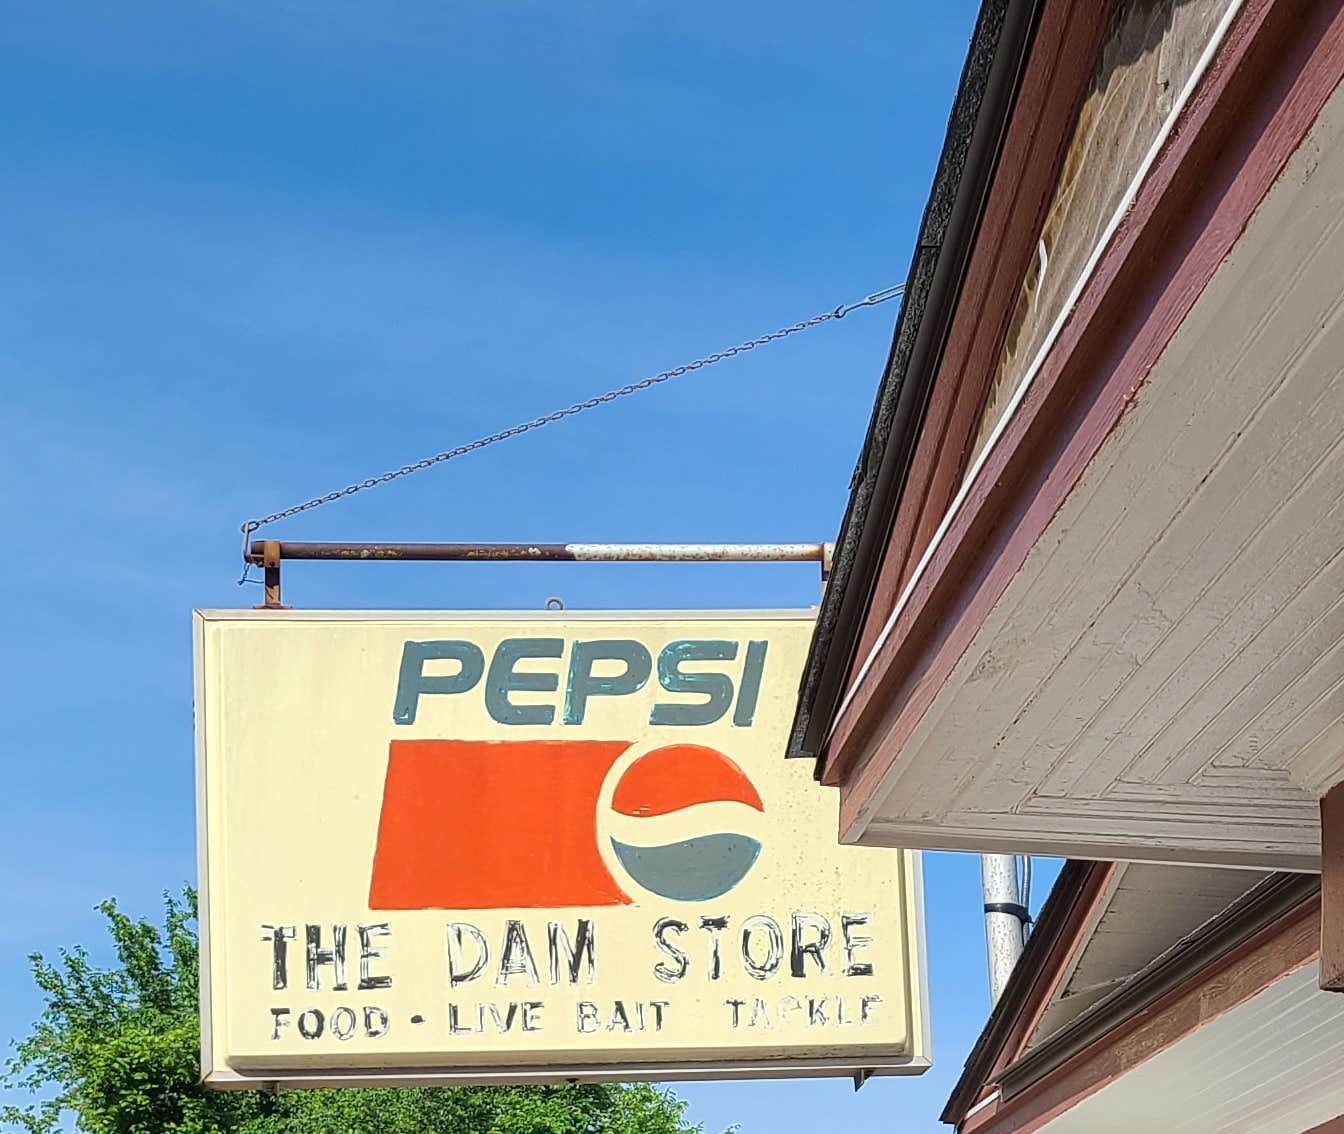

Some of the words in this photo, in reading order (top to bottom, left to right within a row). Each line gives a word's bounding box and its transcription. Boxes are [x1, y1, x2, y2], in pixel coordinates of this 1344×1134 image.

[393, 638, 768, 727] PEPSI
[260, 922, 393, 991] THE
[446, 919, 596, 989] DAM
[652, 911, 875, 985] STORE
[270, 1006, 391, 1041] FOOD
[448, 1001, 545, 1036] LIVE
[576, 1000, 671, 1034] BAIT
